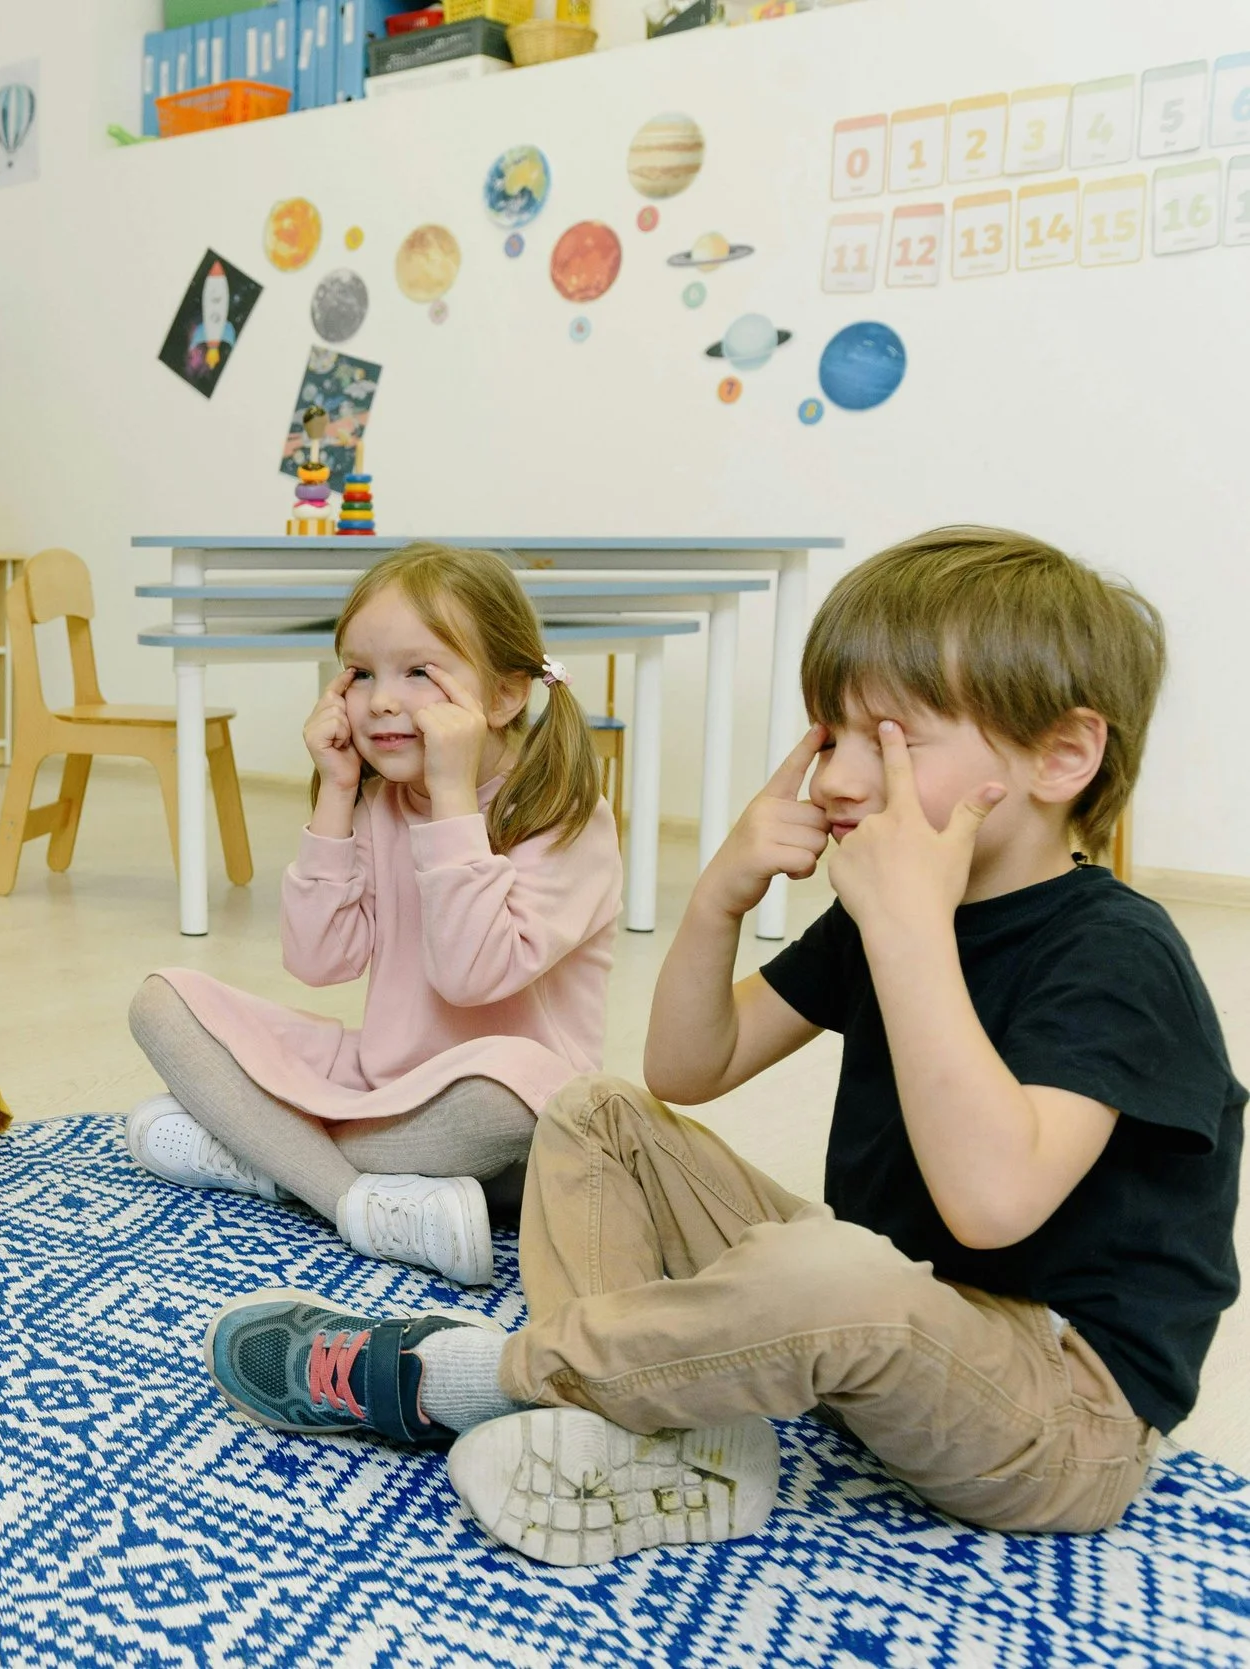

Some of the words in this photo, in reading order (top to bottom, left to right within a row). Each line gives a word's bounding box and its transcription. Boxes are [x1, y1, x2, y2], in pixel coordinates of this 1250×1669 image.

[1160, 98, 1185, 133] 5
[1231, 86, 1250, 122] 6
[964, 128, 987, 161] 2
[1022, 119, 1047, 151] 3
[1087, 112, 1114, 144] 4
[847, 148, 870, 179] 0
[907, 138, 927, 171] 1
[1087, 208, 1137, 246] 15
[1162, 193, 1213, 233] 16
[959, 223, 1004, 258] 13
[1024, 213, 1072, 248] 14
[831, 242, 870, 274] 11
[894, 234, 937, 268] 12
